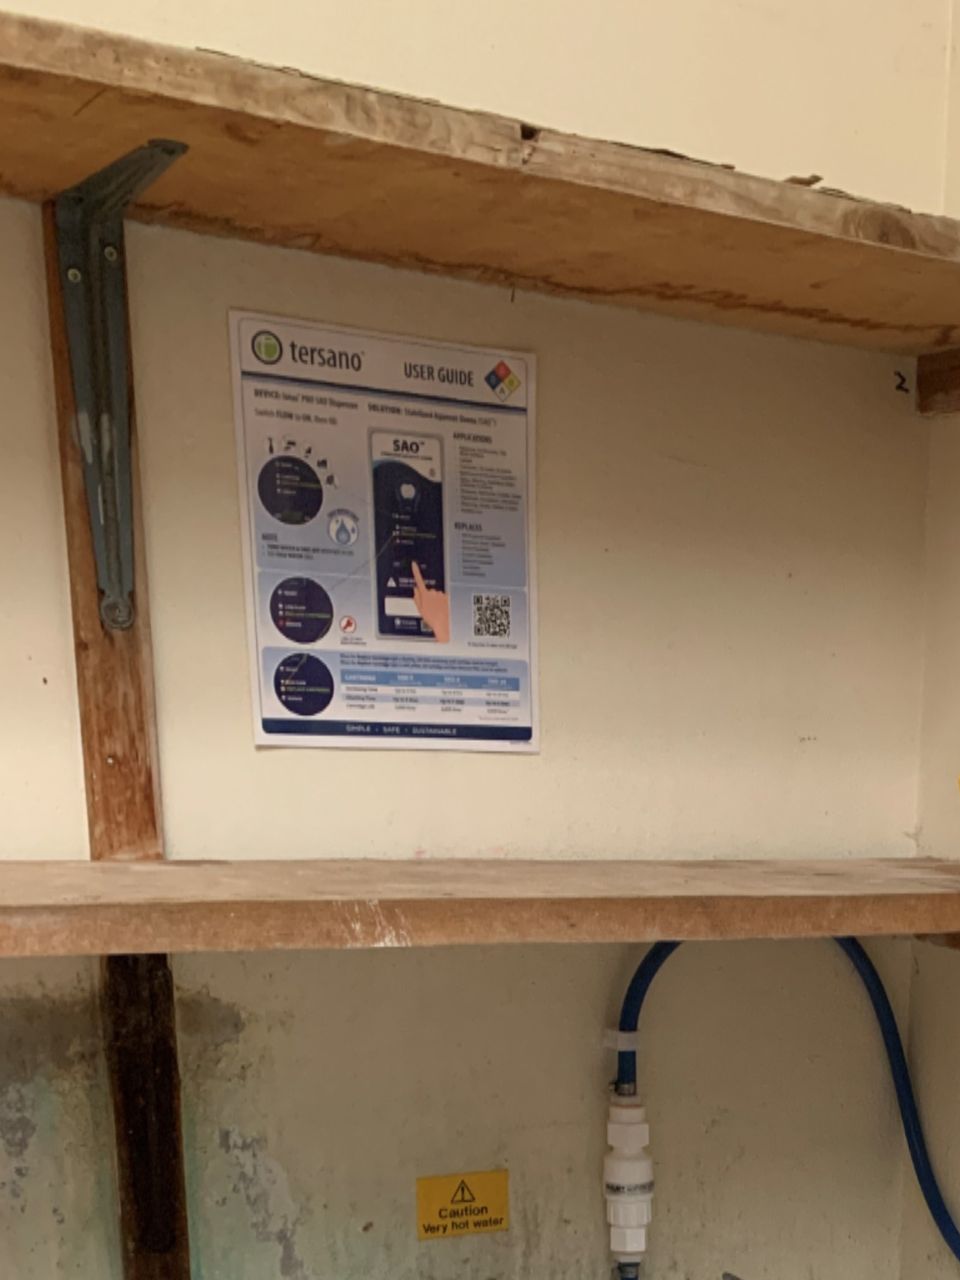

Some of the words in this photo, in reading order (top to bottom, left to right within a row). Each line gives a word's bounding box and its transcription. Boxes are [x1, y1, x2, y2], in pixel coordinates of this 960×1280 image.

[290, 341, 363, 372] tersano
[404, 362, 435, 381] USER
[438, 365, 475, 387] GUIDE
[383, 725, 400, 734] SAFE
[412, 726, 458, 736] SUSTAINABLE
[438, 1204, 489, 1219] Caution
[422, 1223, 448, 1235] Very
[451, 1220, 470, 1231] hot
[473, 1216, 504, 1229] water
